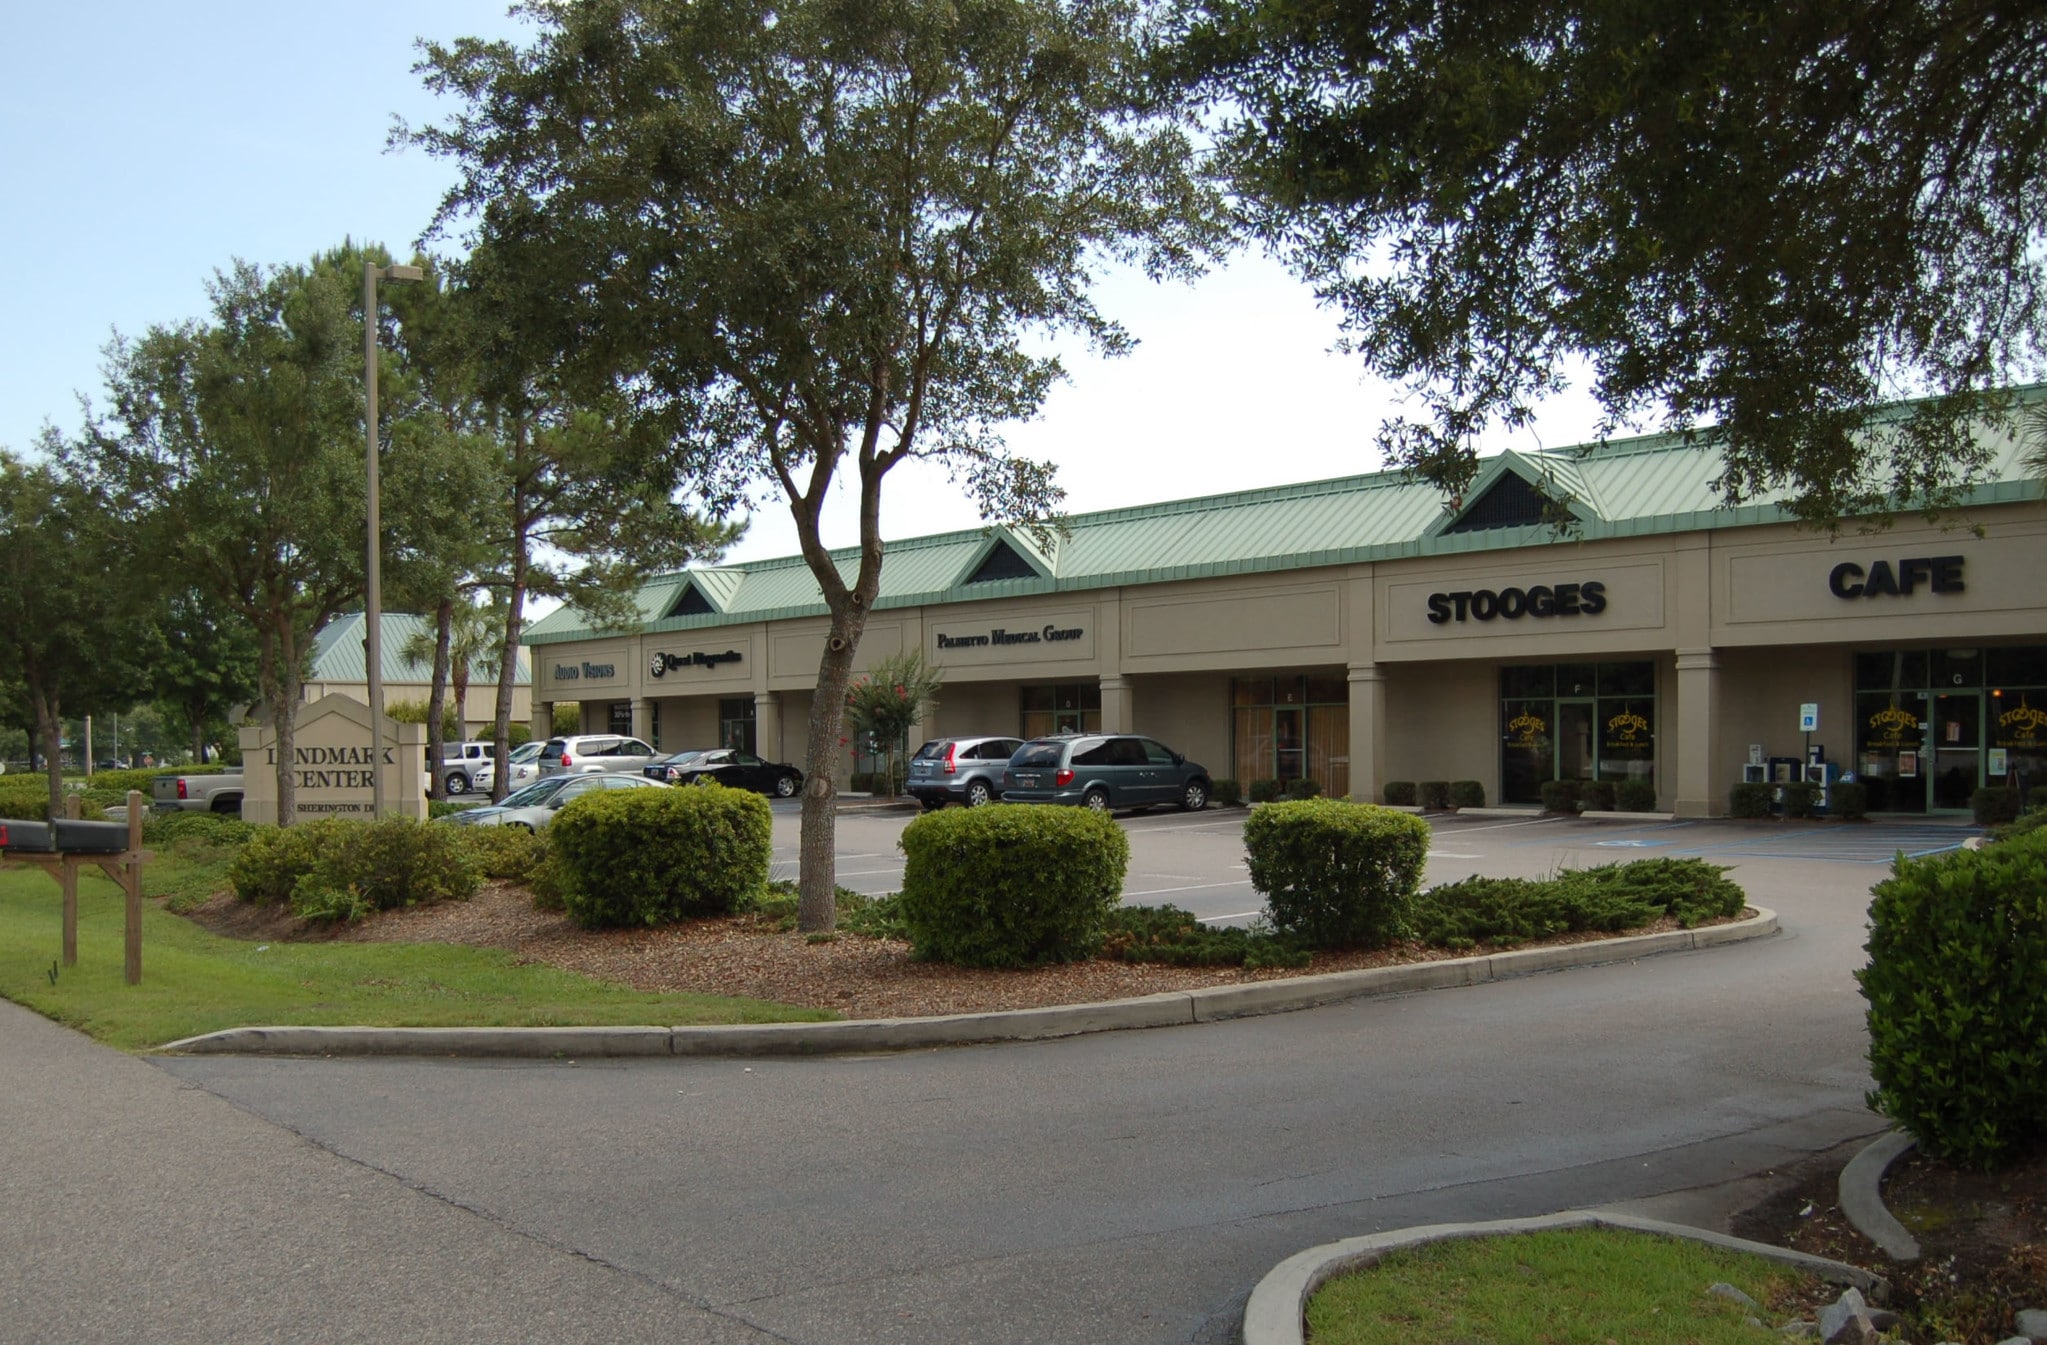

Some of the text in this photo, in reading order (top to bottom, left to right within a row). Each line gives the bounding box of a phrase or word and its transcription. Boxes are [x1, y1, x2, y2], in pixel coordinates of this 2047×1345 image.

[1829, 555, 1965, 599] CAFE
[1427, 581, 1607, 624] STOOGES
[991, 629, 1040, 645] MEDICAL
[1043, 625, 1083, 641] GROUP
[1953, 673, 1962, 684] G
[1574, 684, 1581, 693] F
[266, 746, 395, 765] LNDMARK
[297, 803, 360, 813] SHERINGTON
